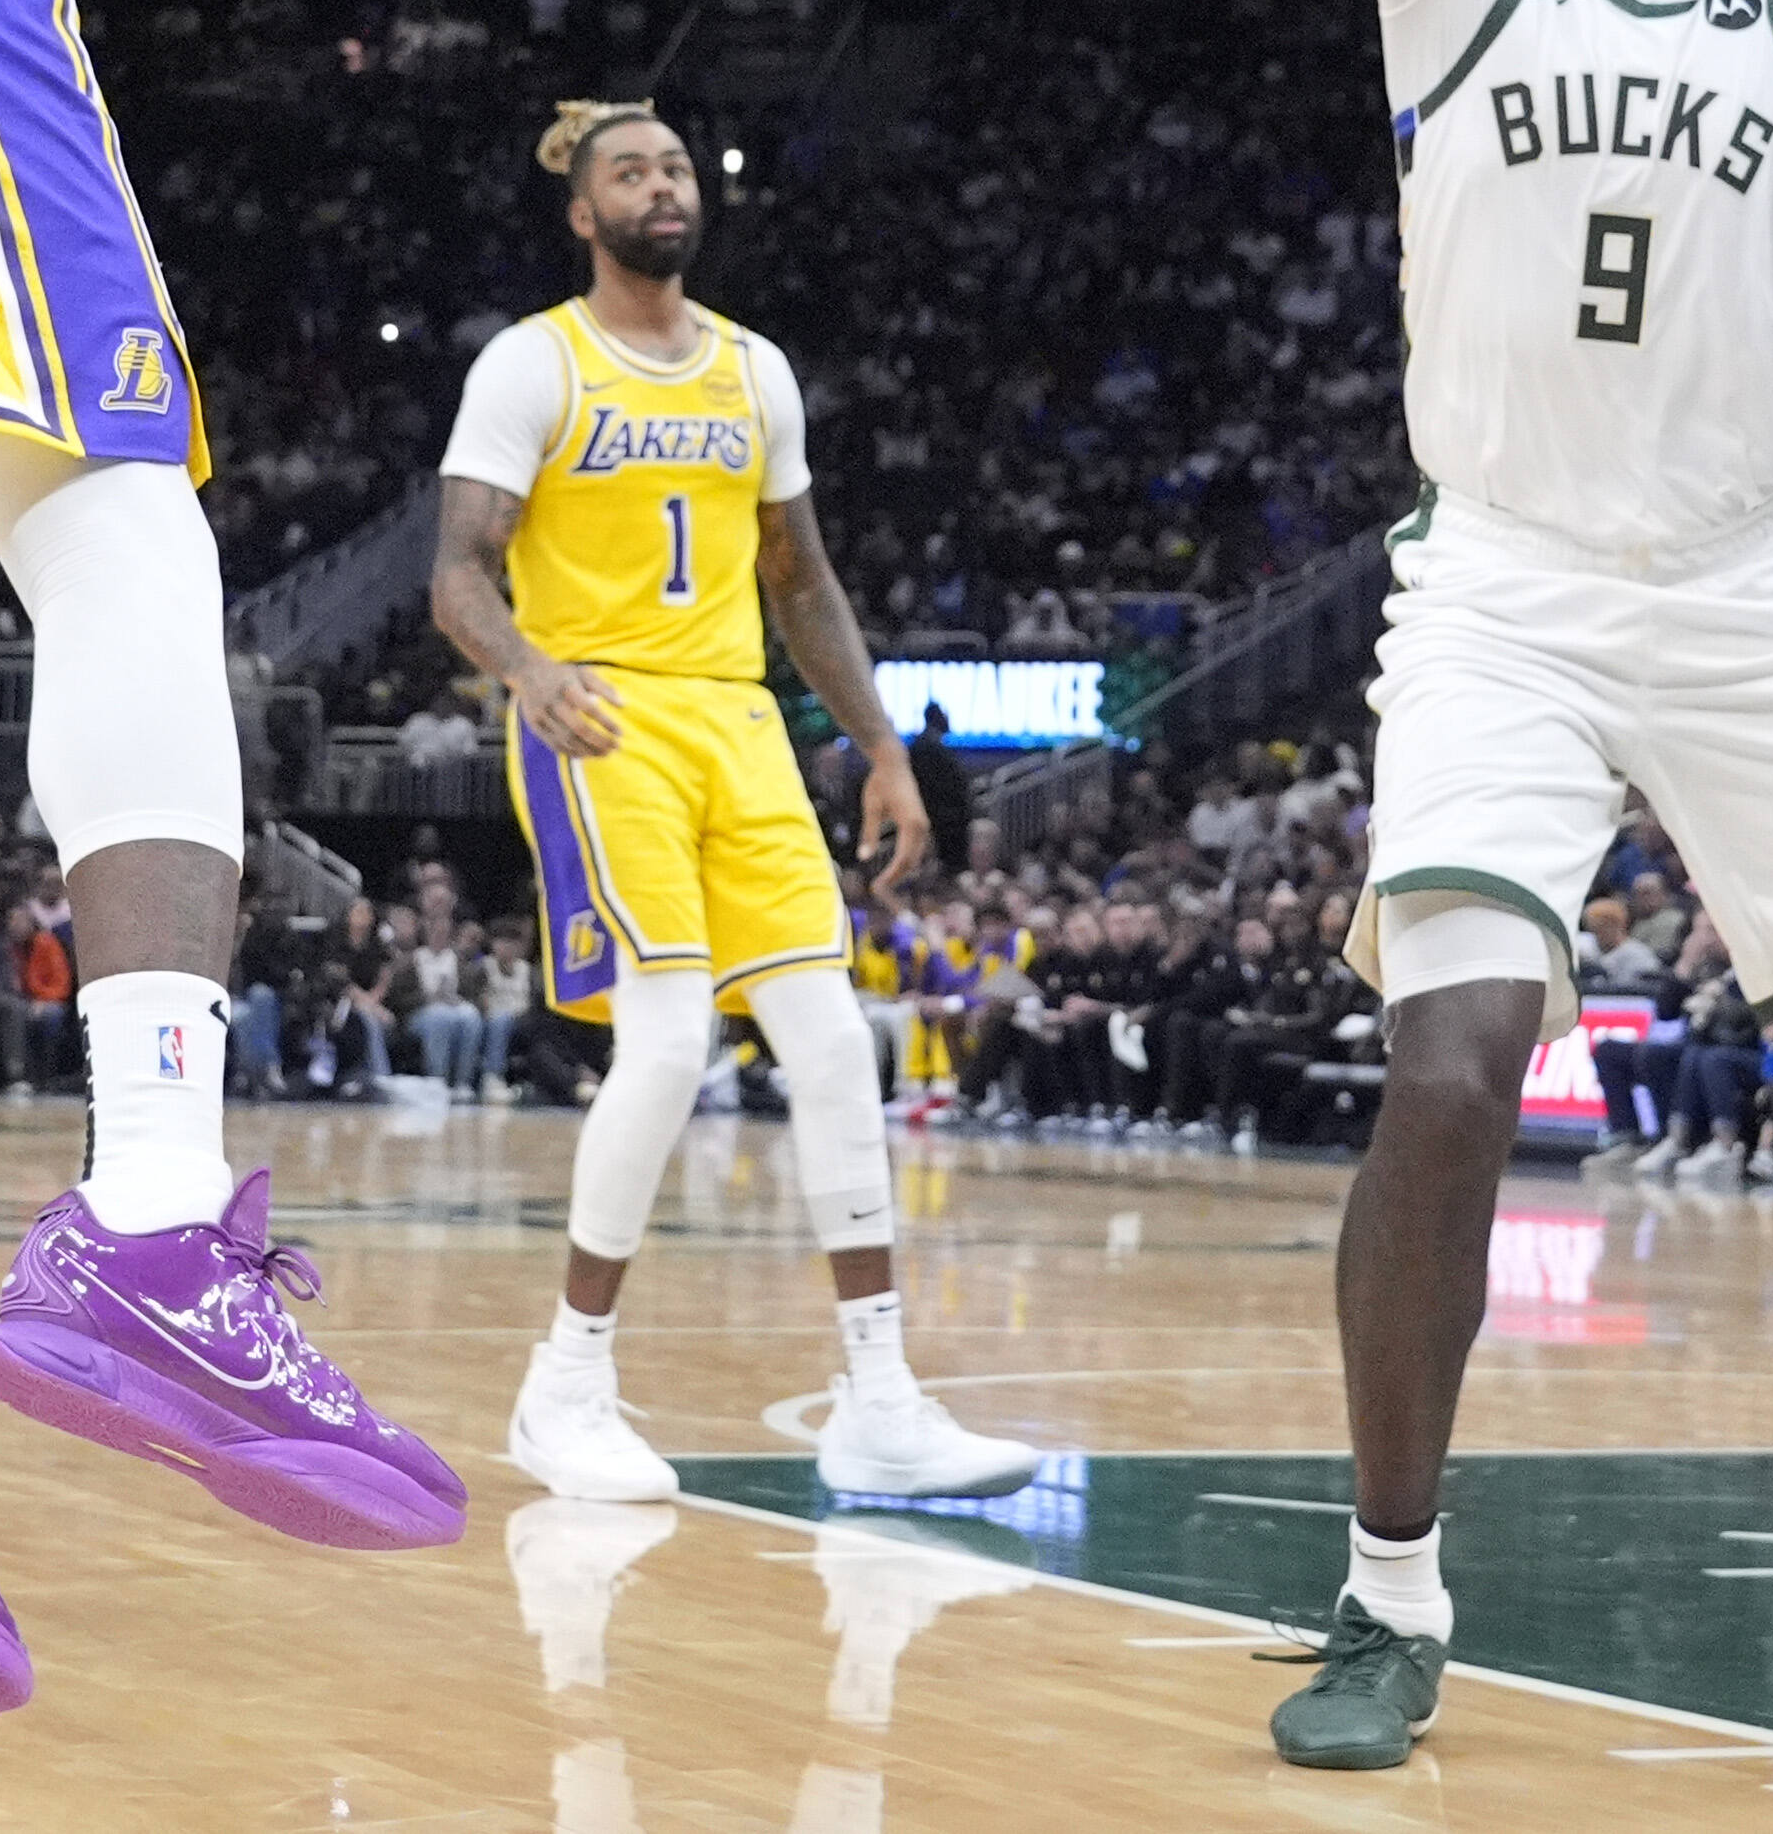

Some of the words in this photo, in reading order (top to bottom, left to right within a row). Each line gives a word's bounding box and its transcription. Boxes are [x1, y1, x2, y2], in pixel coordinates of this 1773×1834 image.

[1575, 211, 1654, 348] 9
[571, 406, 754, 472] LAKERS
[661, 493, 697, 607] 1
